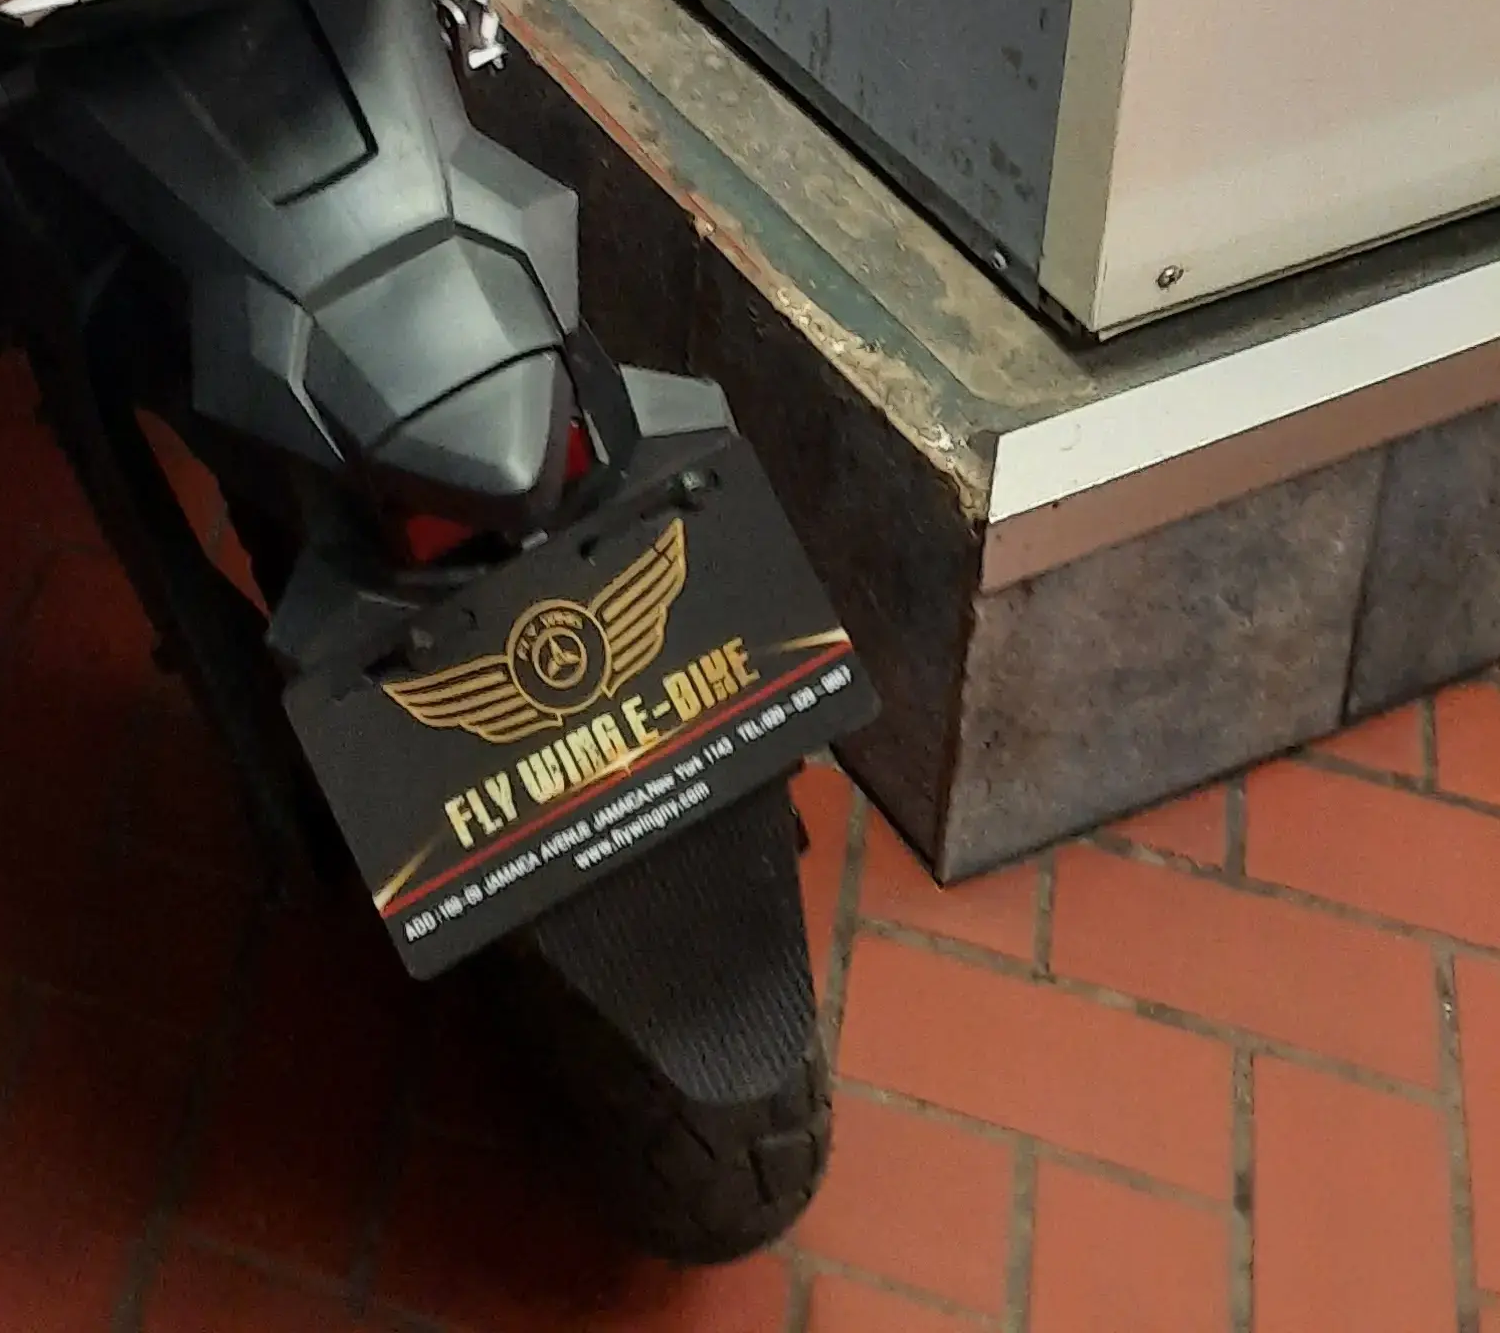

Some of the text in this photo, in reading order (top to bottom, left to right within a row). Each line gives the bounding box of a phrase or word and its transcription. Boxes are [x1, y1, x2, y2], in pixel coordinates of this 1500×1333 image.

[444, 636, 761, 850] FLY WING E-BIKE
[573, 781, 711, 871] www.flywingny.com
[482, 850, 542, 896] JAMAICA
